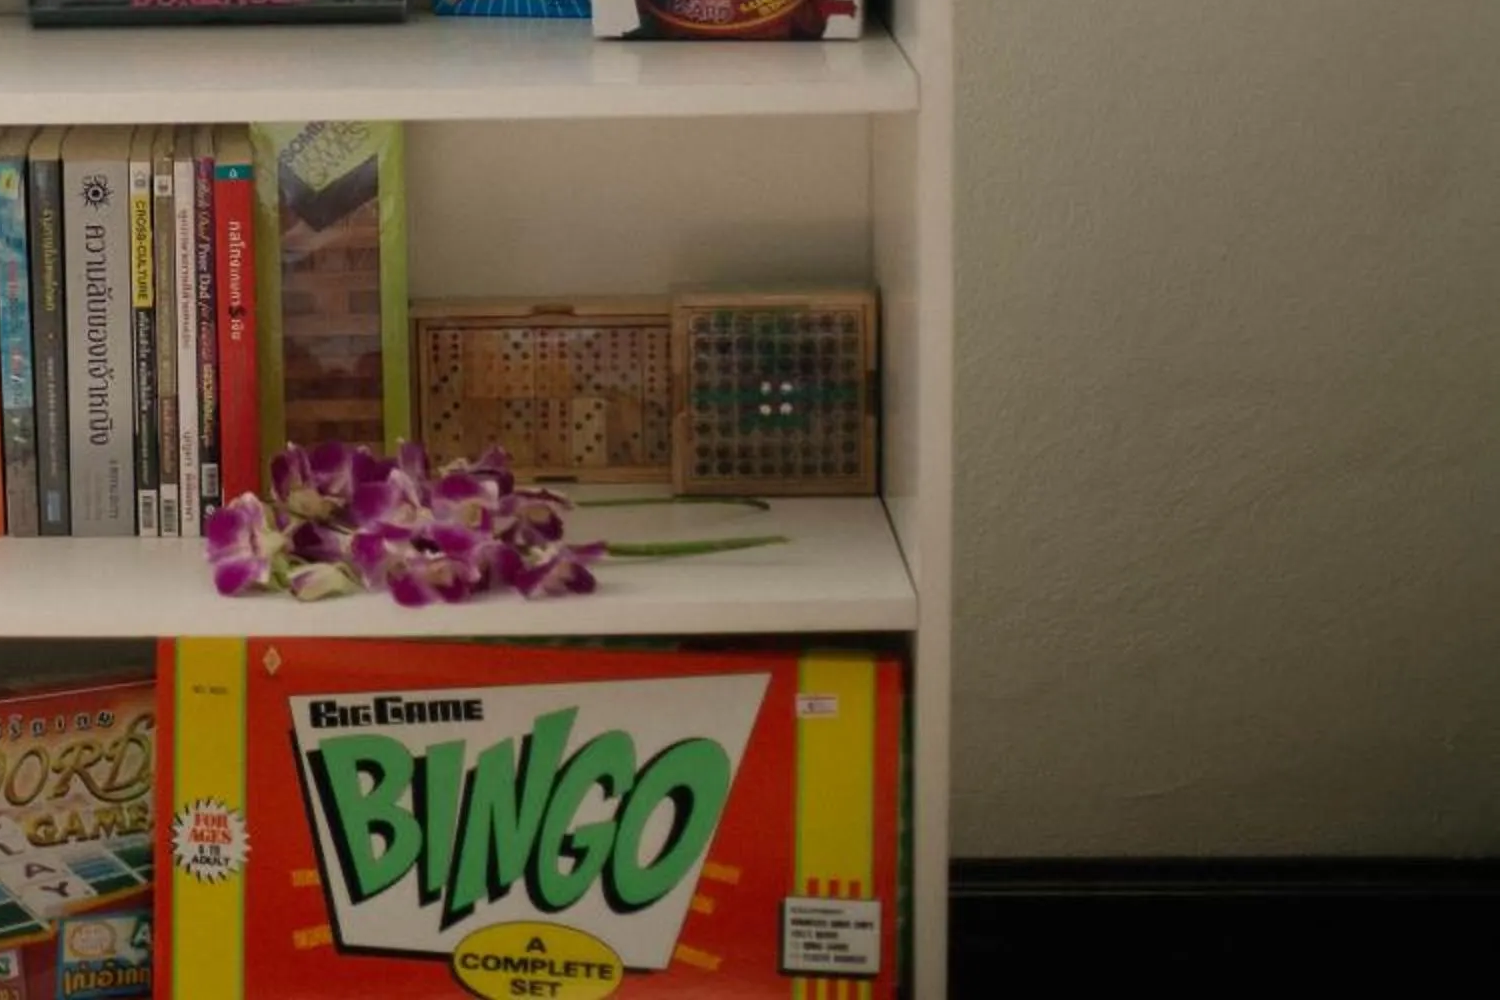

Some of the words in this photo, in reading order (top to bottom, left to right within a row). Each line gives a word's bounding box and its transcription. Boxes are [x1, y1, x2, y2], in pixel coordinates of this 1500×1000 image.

[134, 200, 149, 300] CROSS-CULTURE
[82, 225, 112, 446] ความลับของเจ้าหญิง
[194, 813, 228, 828] FOR
[310, 705, 732, 930] BINGO
[189, 828, 232, 844] AGES
[191, 856, 230, 868] ADULT
[526, 936, 547, 954] A
[460, 953, 614, 981] COMPLETE
[510, 978, 563, 997] SET
